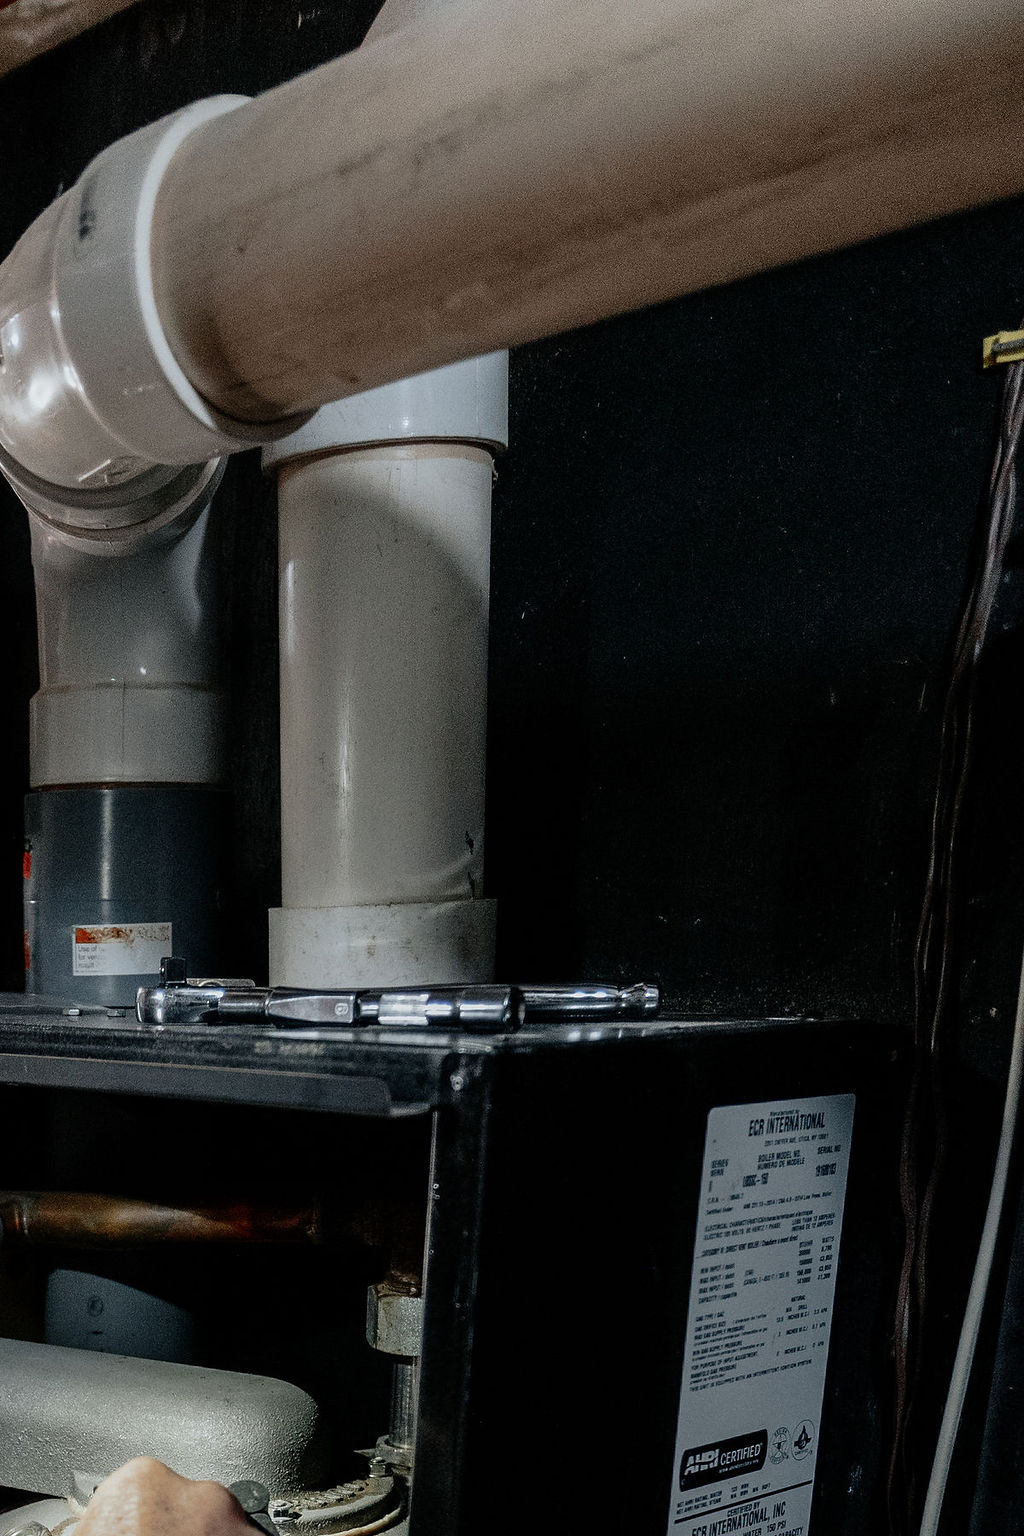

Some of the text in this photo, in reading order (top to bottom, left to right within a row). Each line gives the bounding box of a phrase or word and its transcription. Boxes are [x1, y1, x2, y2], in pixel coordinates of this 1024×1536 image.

[749, 1119, 765, 1136] ECR
[766, 1112, 826, 1134] INTERNATIONAL
[776, 1151, 792, 1160] MODEL
[720, 1443, 761, 1466] CERTIFIED
[727, 1502, 760, 1517] CERTIFIED BY
[773, 1501, 786, 1518] INC
[767, 1523, 776, 1533] 150
[777, 1520, 787, 1530] PSI
